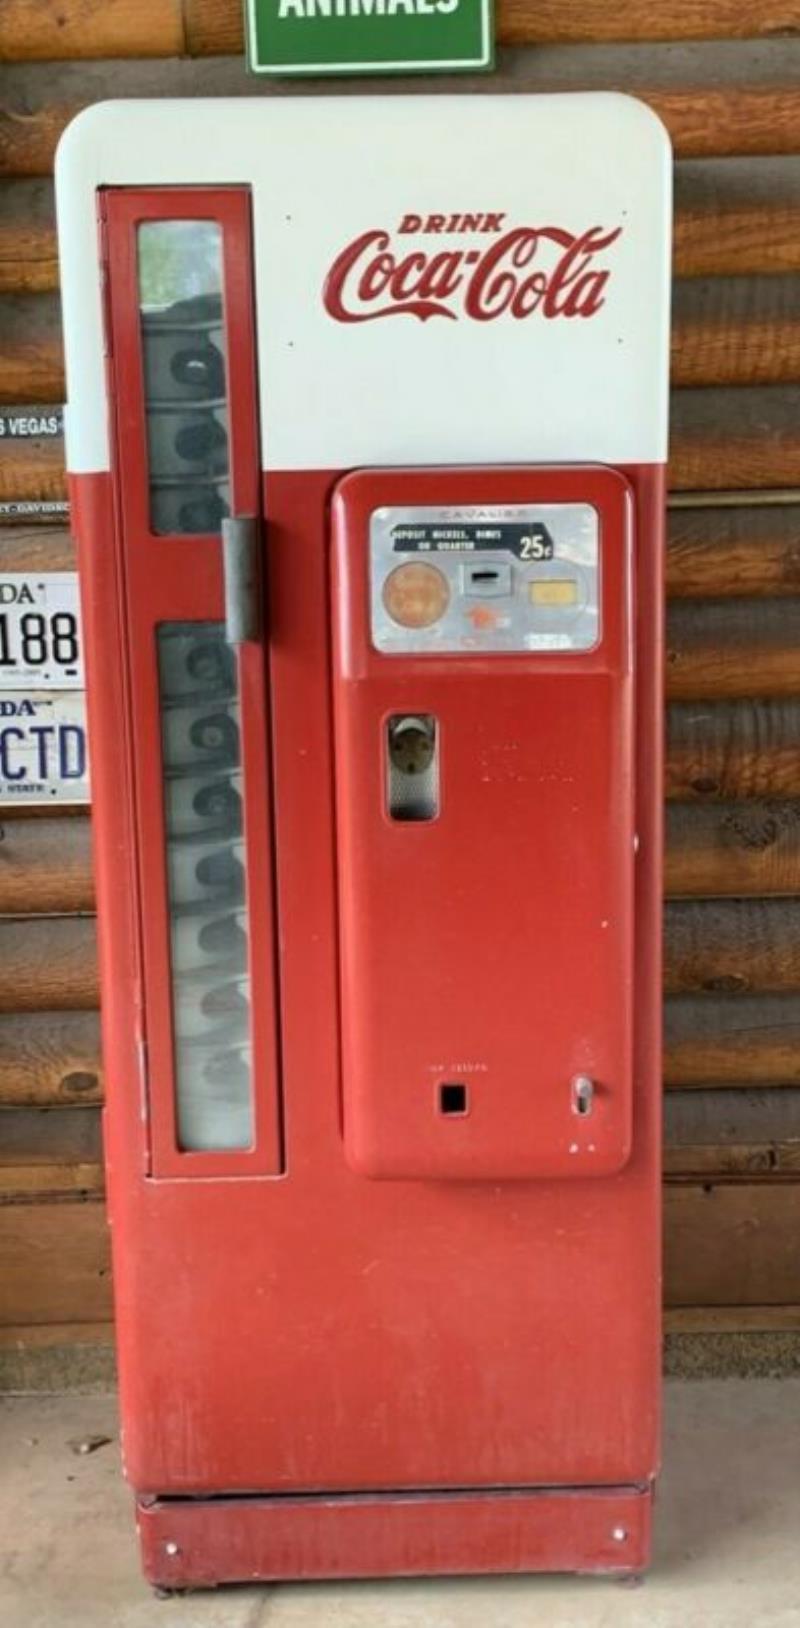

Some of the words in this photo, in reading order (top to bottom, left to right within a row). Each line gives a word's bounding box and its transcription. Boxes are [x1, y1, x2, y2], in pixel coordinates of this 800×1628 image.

[398, 213, 506, 235] DRINK
[322, 226, 624, 324] Coca-Cola
[8, 417, 58, 436] VEGAS
